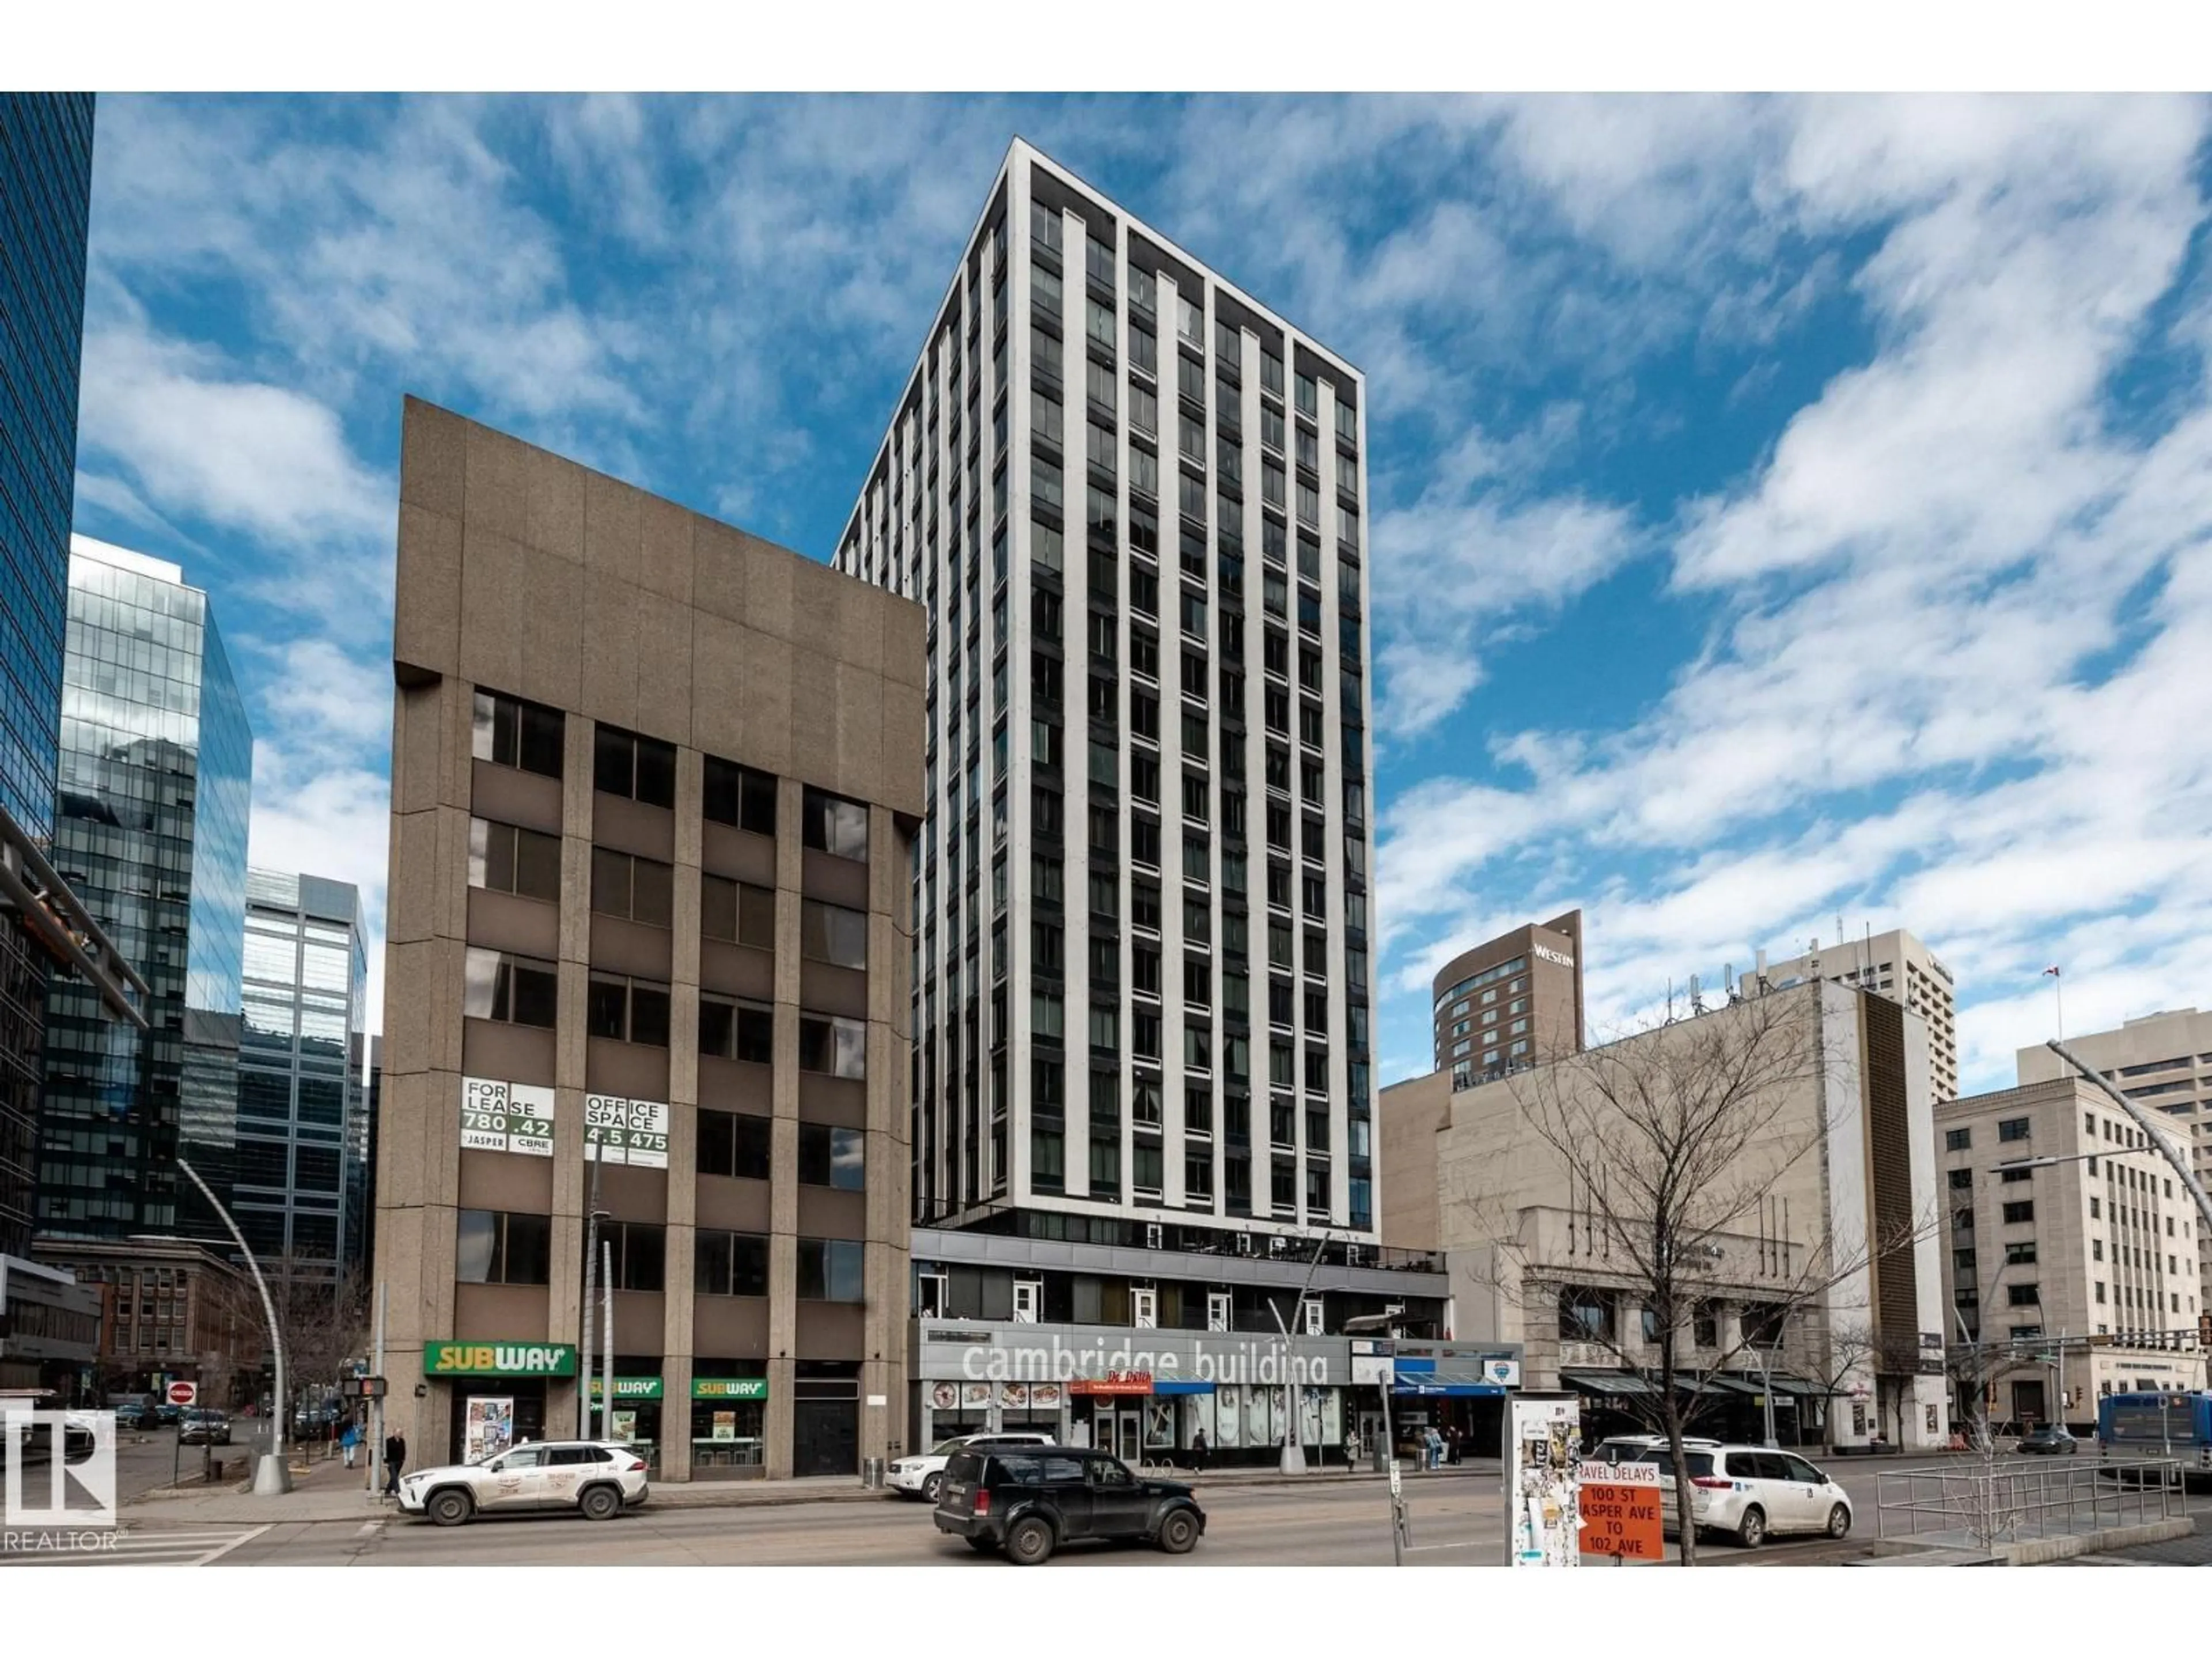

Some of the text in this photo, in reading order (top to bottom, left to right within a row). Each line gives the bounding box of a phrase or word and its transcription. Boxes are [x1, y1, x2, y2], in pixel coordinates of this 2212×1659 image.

[1534, 943, 1574, 968] WESTIN
[469, 1082, 506, 1098] FOR
[468, 1135, 503, 1146] JASPER
[519, 1139, 548, 1149] CBRE
[436, 1347, 565, 1371] SUBWAY
[696, 1382, 762, 1394] SUBWAY
[1579, 1466, 1655, 1481] RAVEL DELAYS
[1591, 1487, 1637, 1502] 100 ST
[1629, 1506, 1655, 1520] AVE
[1607, 1521, 1623, 1535] TO
[1590, 1537, 1643, 1554] 102 AVE
